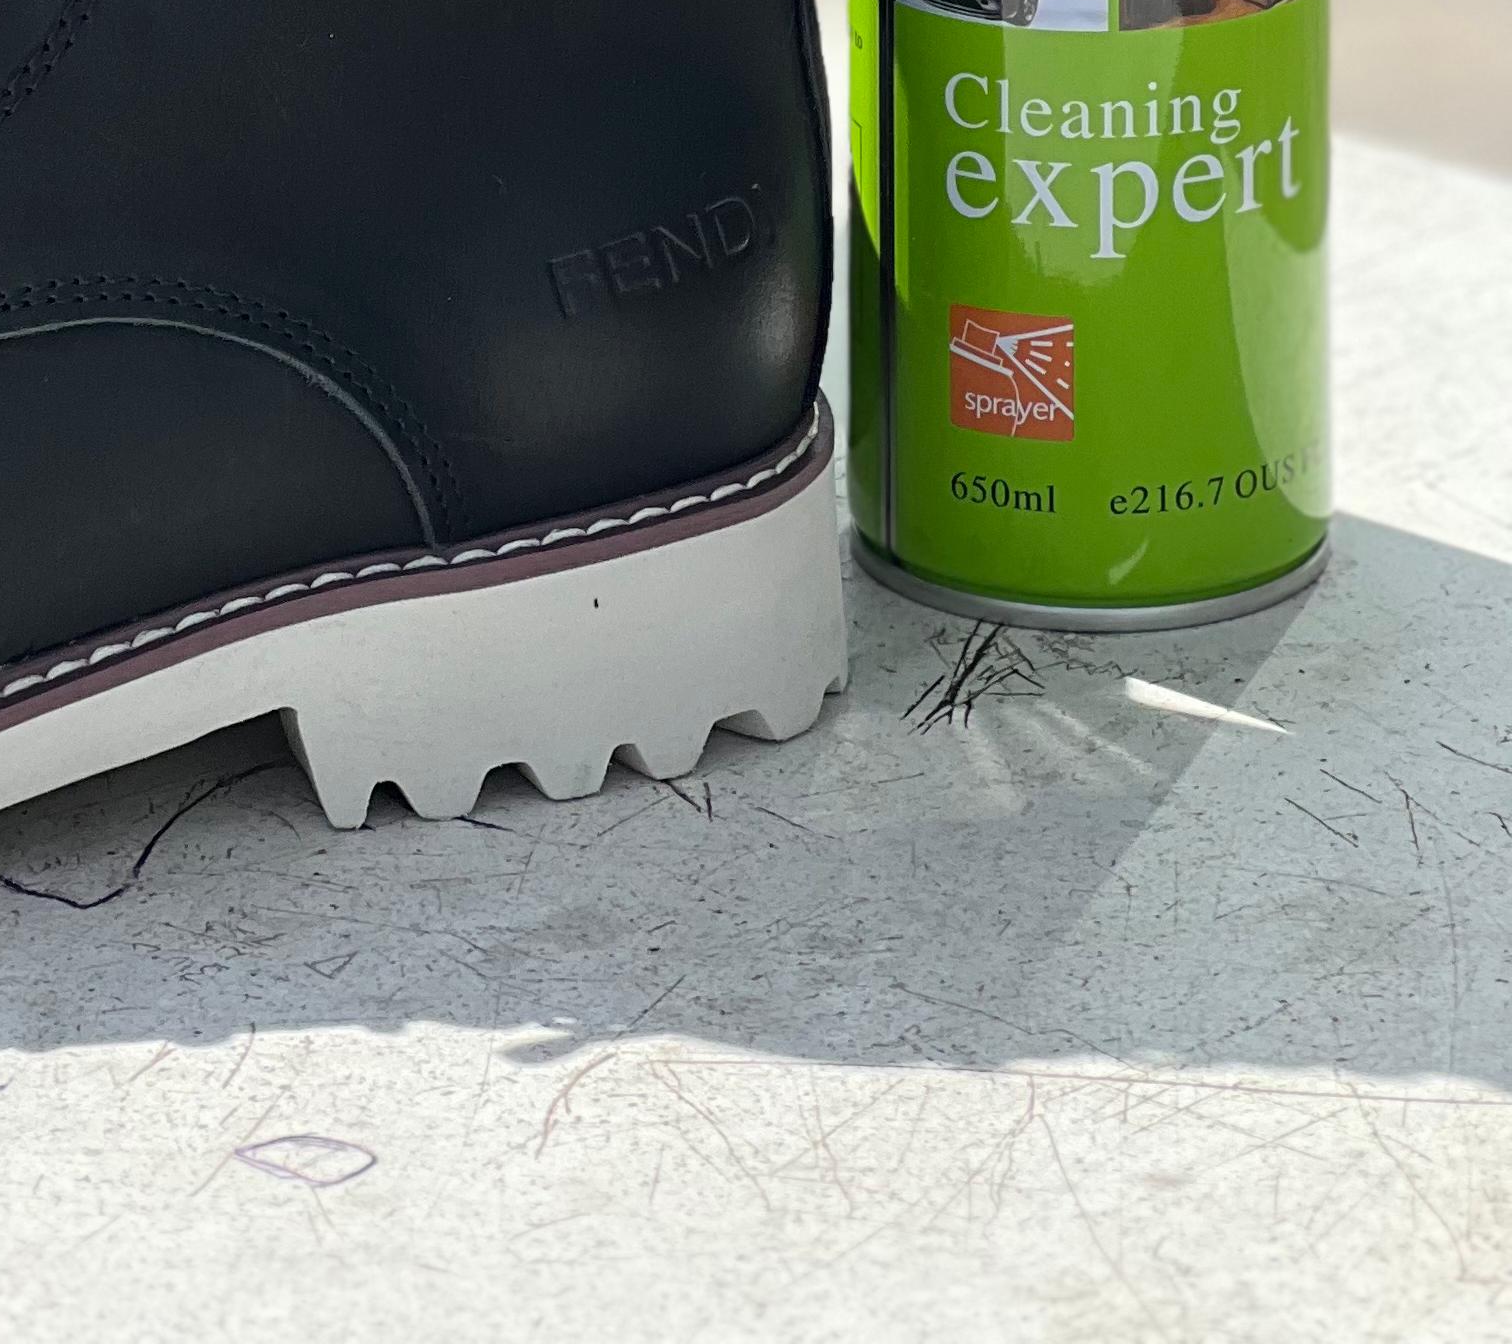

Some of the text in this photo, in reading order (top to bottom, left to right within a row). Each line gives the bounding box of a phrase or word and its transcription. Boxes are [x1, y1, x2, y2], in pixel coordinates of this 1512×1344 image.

[944, 72, 1242, 145] Cleaning
[945, 116, 1303, 260] expert
[964, 391, 1060, 426] sprayer
[950, 471, 1056, 513] 650ml
[1110, 476, 1224, 515] e216.7
